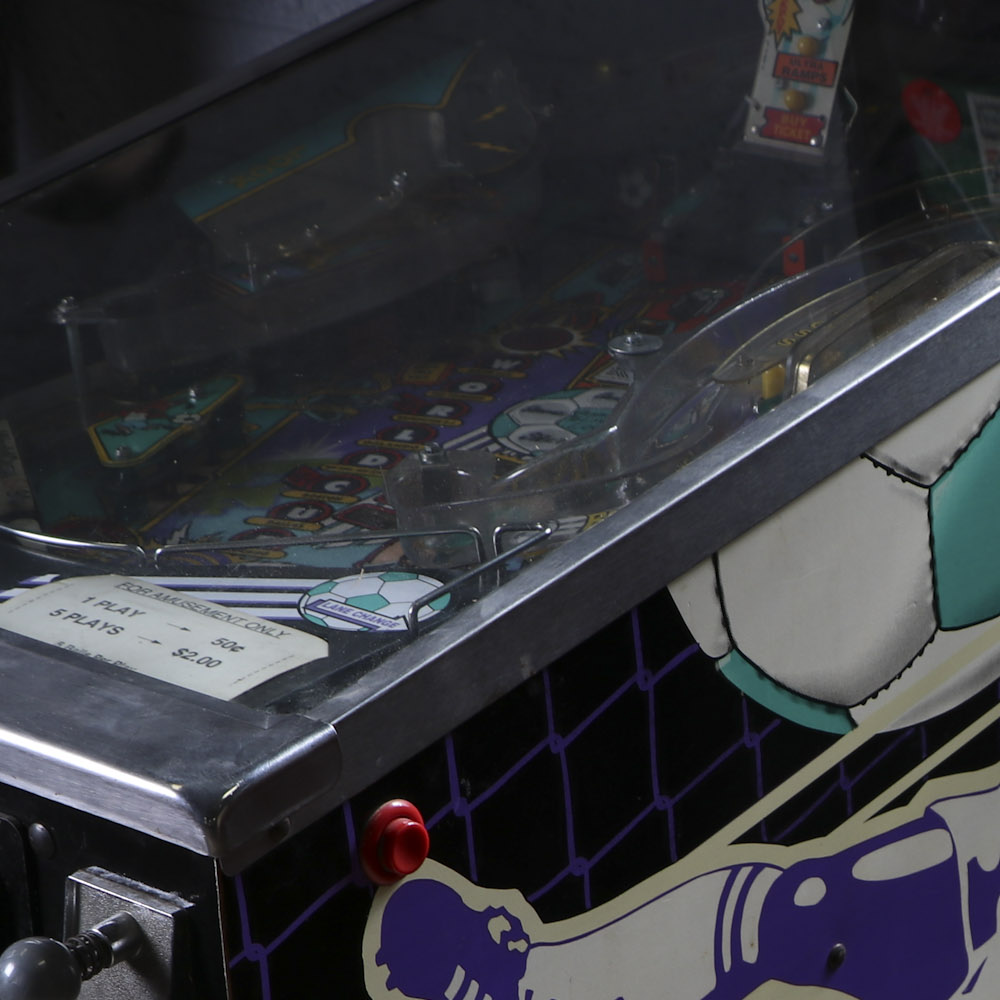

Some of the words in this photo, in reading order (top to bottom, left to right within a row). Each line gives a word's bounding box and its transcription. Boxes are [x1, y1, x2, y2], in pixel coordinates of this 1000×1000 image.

[48, 608, 68, 618] 5
[62, 612, 125, 636] PLAYS
[171, 647, 223, 669] $2.00
[81, 596, 97, 604] 1
[93, 599, 147, 618] PLAY
[210, 637, 246, 653] 50¢
[114, 581, 154, 598] FOR
[152, 590, 248, 627] AMUSEMENT
[244, 621, 292, 640] ONLY
[321, 601, 353, 615] LANE
[351, 610, 401, 629] CHANGE
